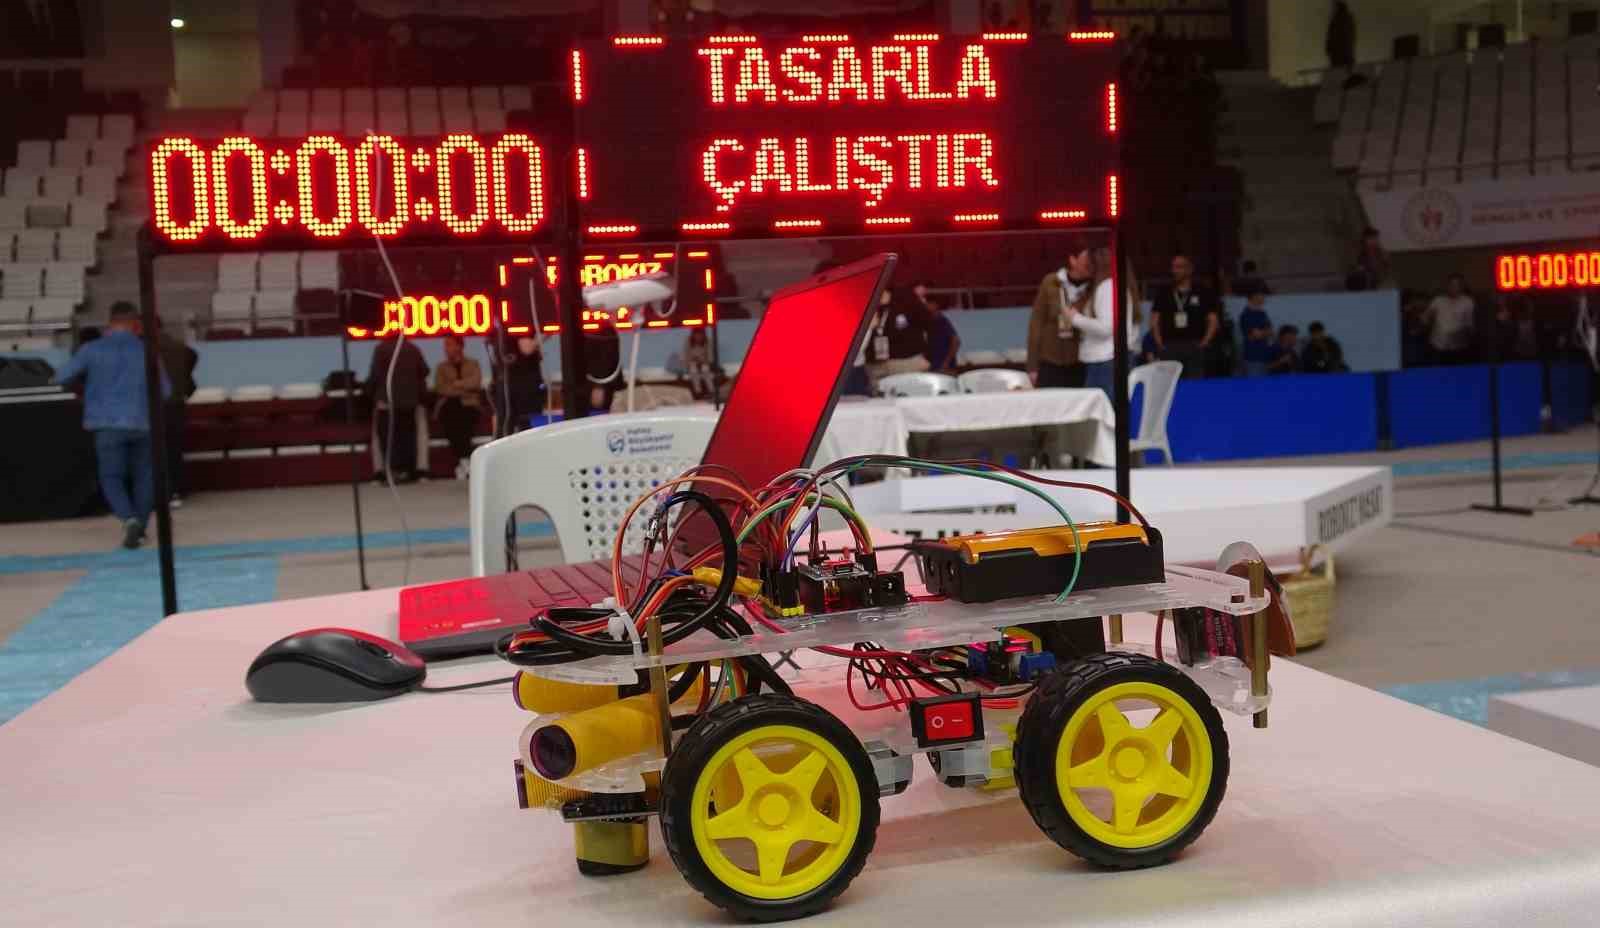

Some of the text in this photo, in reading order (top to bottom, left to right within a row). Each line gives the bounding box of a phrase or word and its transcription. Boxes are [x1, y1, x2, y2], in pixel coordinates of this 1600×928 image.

[698, 45, 997, 103] TASARLA
[152, 134, 544, 240] 00:00:00
[703, 134, 998, 211] ÇALIŞTIR
[347, 294, 491, 337] :00:00
